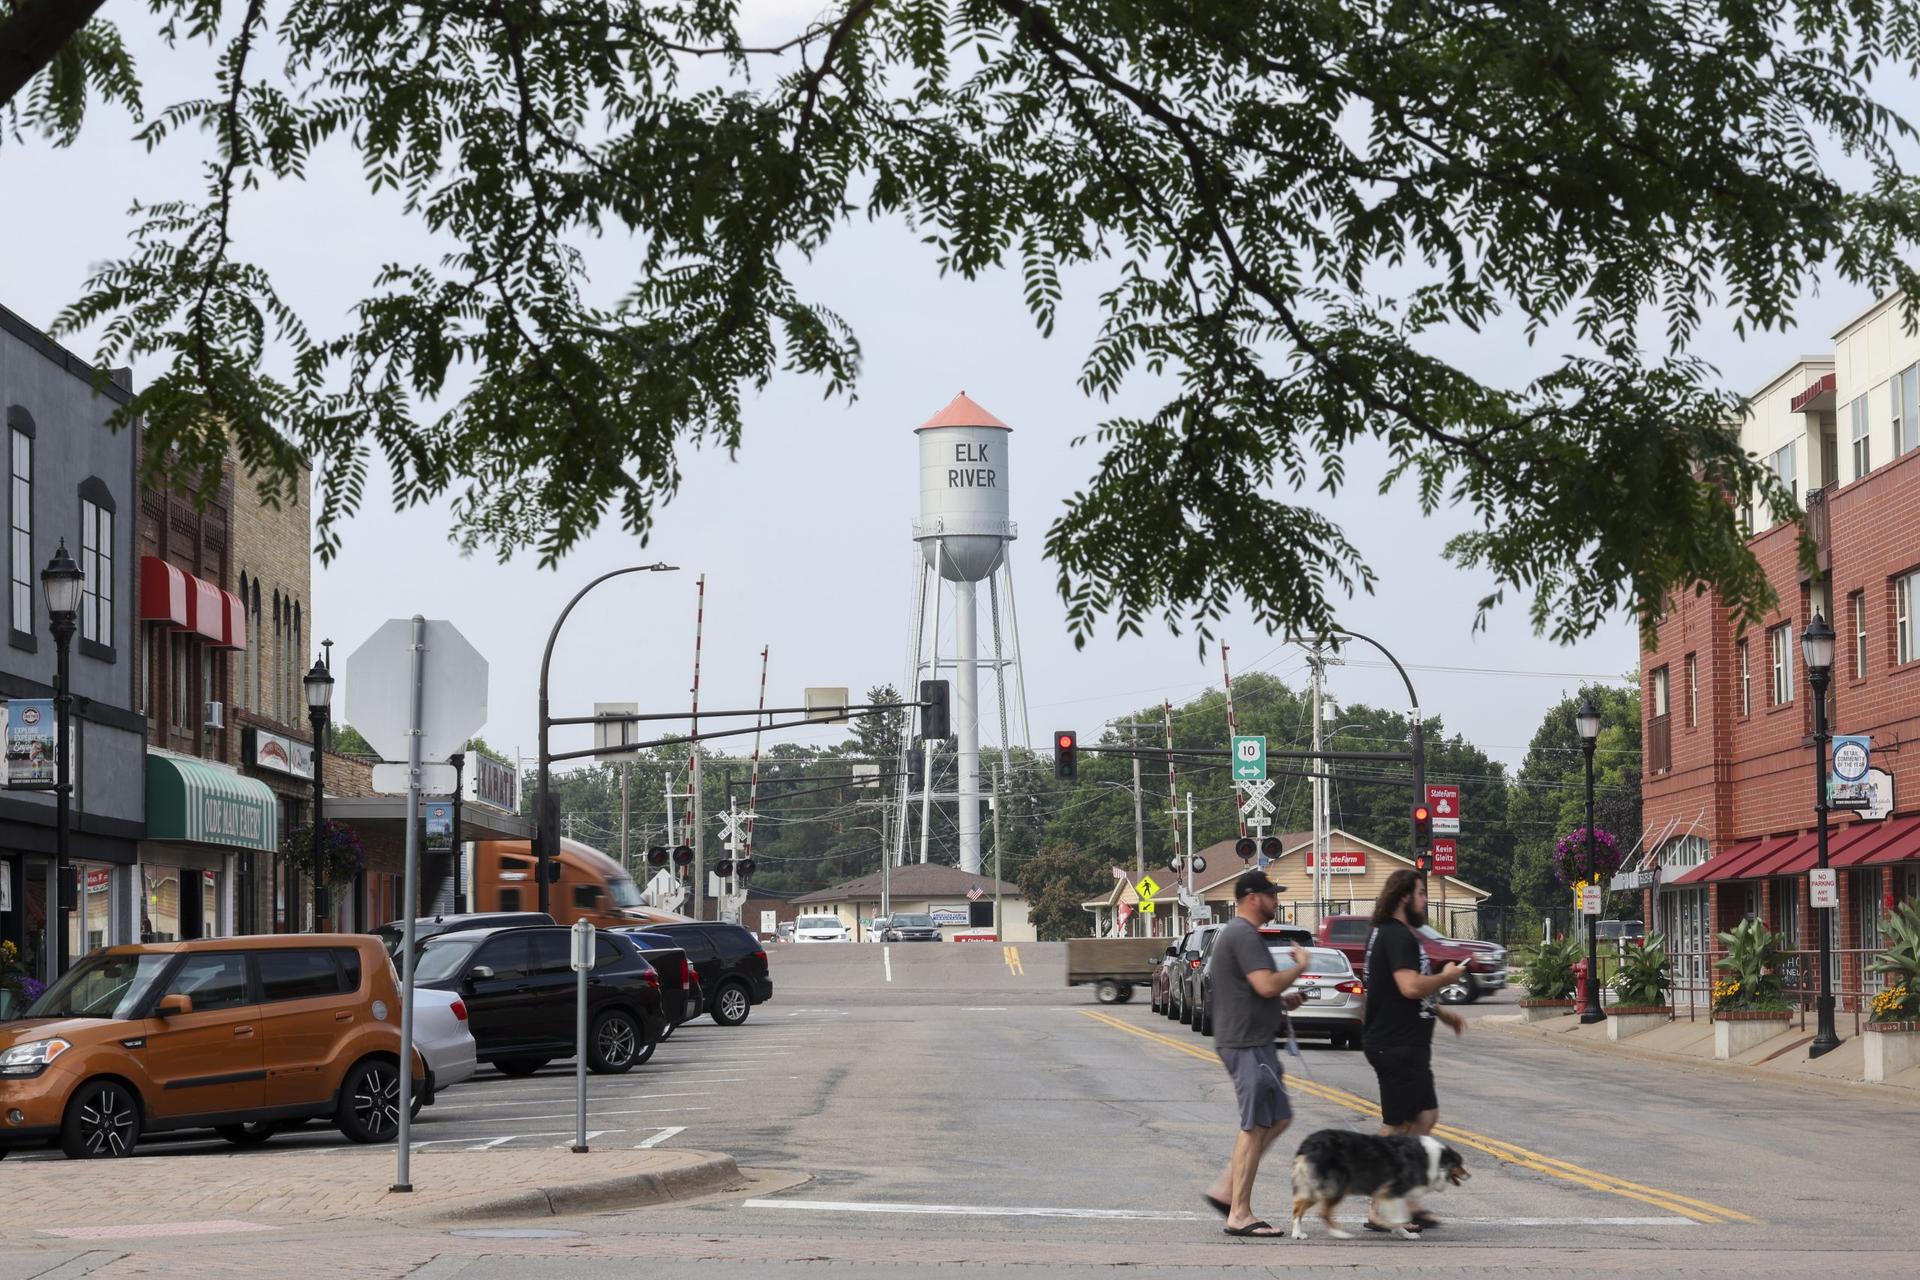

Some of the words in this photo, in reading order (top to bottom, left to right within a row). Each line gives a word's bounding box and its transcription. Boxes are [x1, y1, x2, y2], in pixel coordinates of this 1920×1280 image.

[956, 443, 988, 462] ELK
[948, 469, 996, 488] RIVER
[1243, 746, 1255, 756] 10
[205, 799, 221, 834] OLDE
[222, 801, 239, 836] MAIN
[240, 804, 261, 840] EATERY
[1435, 854, 1453, 862] Gleitz
